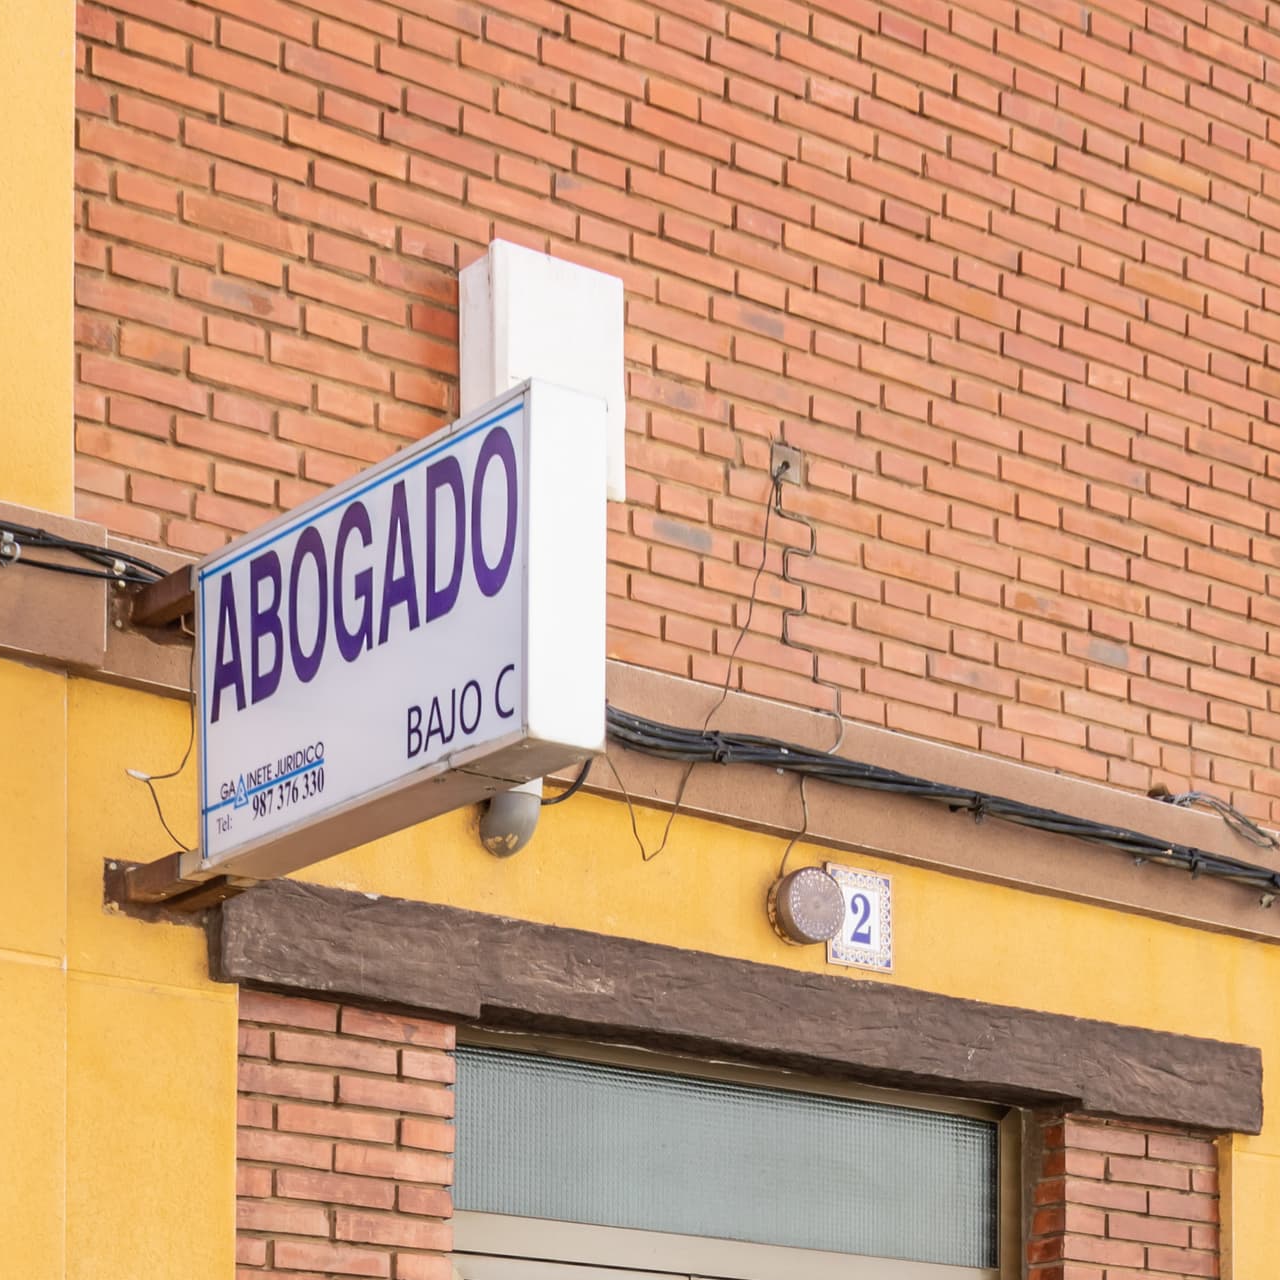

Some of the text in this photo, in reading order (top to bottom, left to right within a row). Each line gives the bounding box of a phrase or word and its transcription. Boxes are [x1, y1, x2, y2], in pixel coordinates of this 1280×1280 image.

[210, 425, 519, 724] ABOGADO
[407, 663, 515, 759] BAJO C
[274, 741, 324, 778] JURIDICO
[252, 767, 325, 821] 987 376 330
[850, 893, 872, 945] 2
